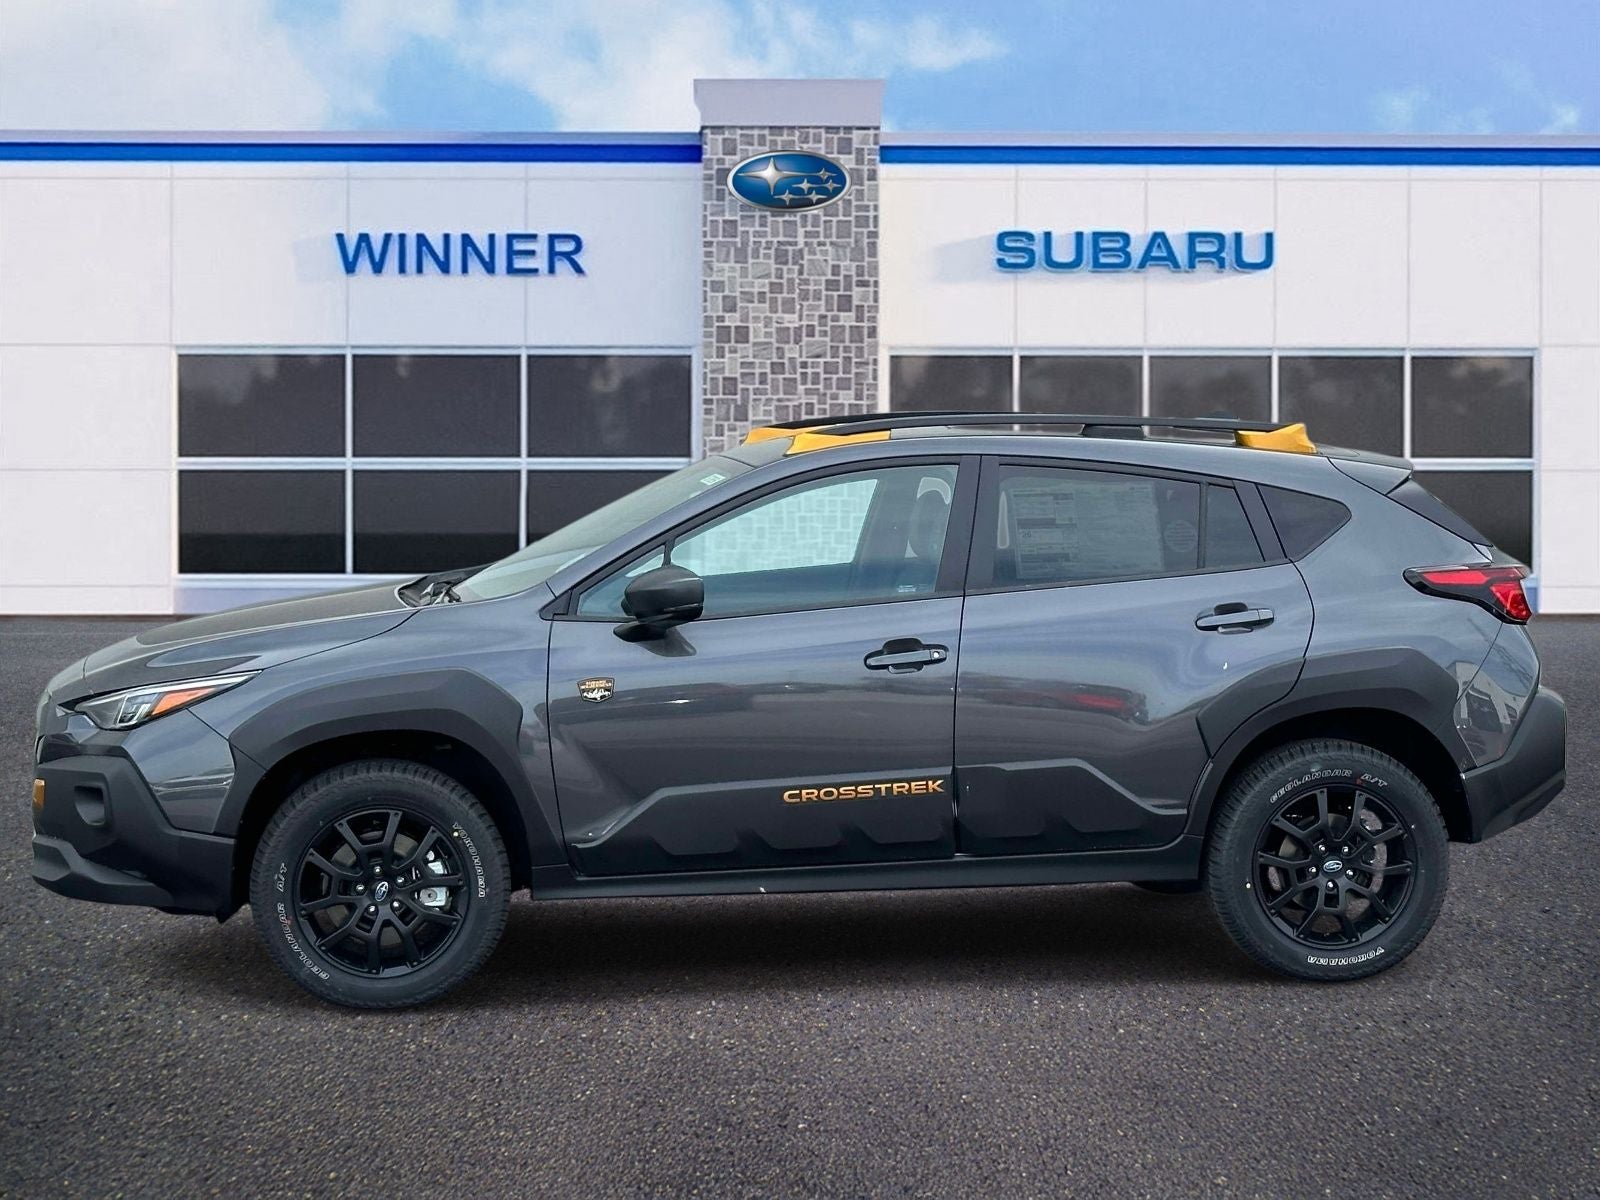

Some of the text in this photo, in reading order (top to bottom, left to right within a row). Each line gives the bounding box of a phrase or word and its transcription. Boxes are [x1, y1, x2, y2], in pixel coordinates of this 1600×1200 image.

[335, 233, 586, 275] WINNER
[996, 231, 1275, 271] SUBARU
[783, 779, 945, 804] CROSSTREK
[1360, 772, 1389, 787] A/T
[452, 821, 486, 898] YOKOHAMA
[1307, 945, 1386, 966] YOKOHAMA
